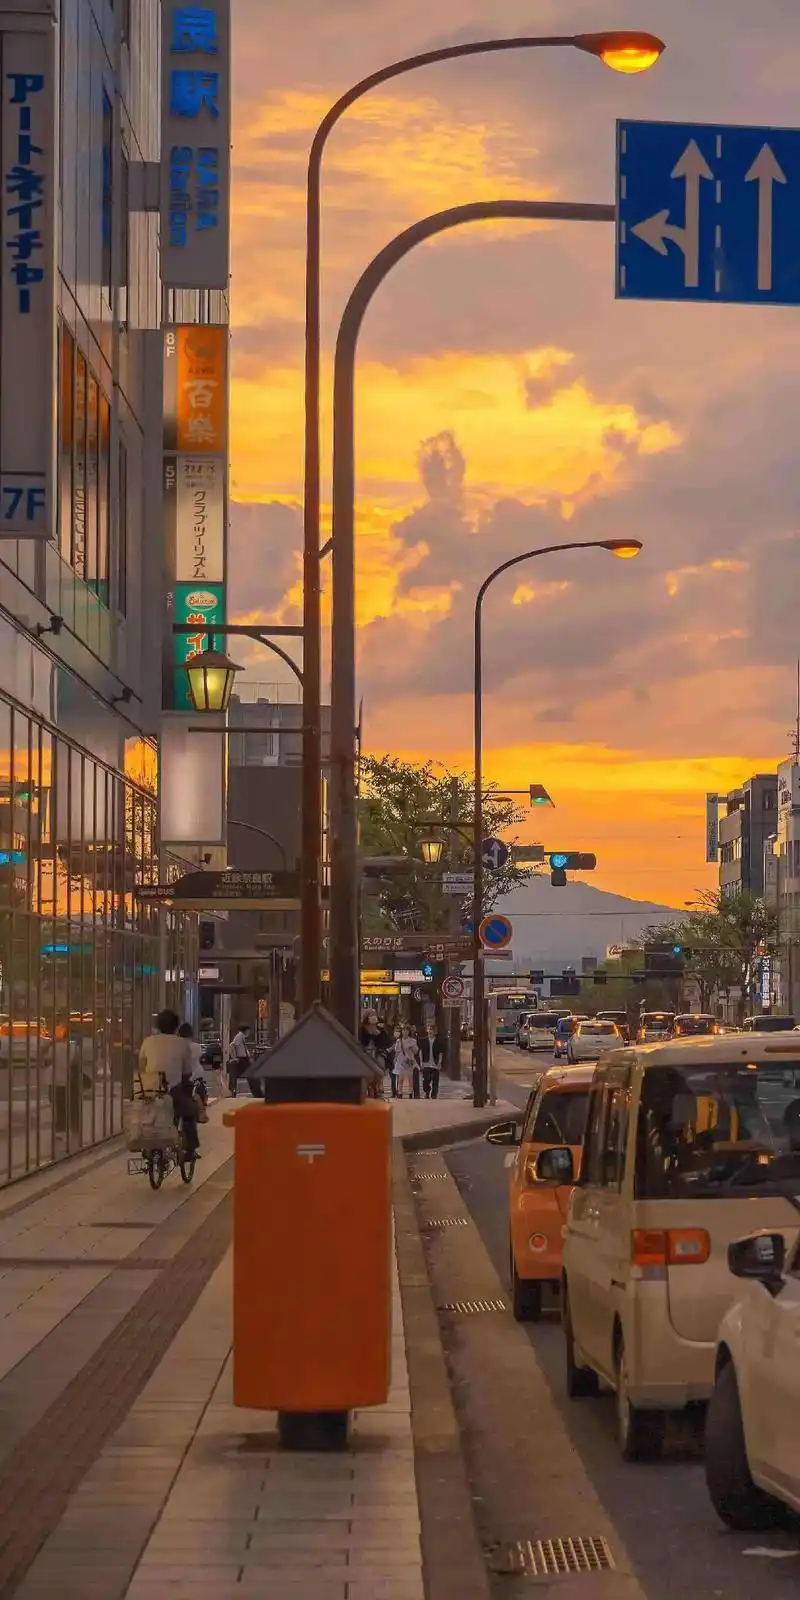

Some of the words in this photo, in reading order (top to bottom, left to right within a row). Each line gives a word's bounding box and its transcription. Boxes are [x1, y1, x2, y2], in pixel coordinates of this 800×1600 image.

[6, 73, 45, 314] アートネイチャー
[168, 145, 194, 247] Station
[195, 146, 219, 231] NARA
[165, 332, 176, 358] 8F
[2, 486, 46, 521] 7F
[165, 464, 176, 490] 5F
[192, 490, 207, 580] クラブツーリズム
